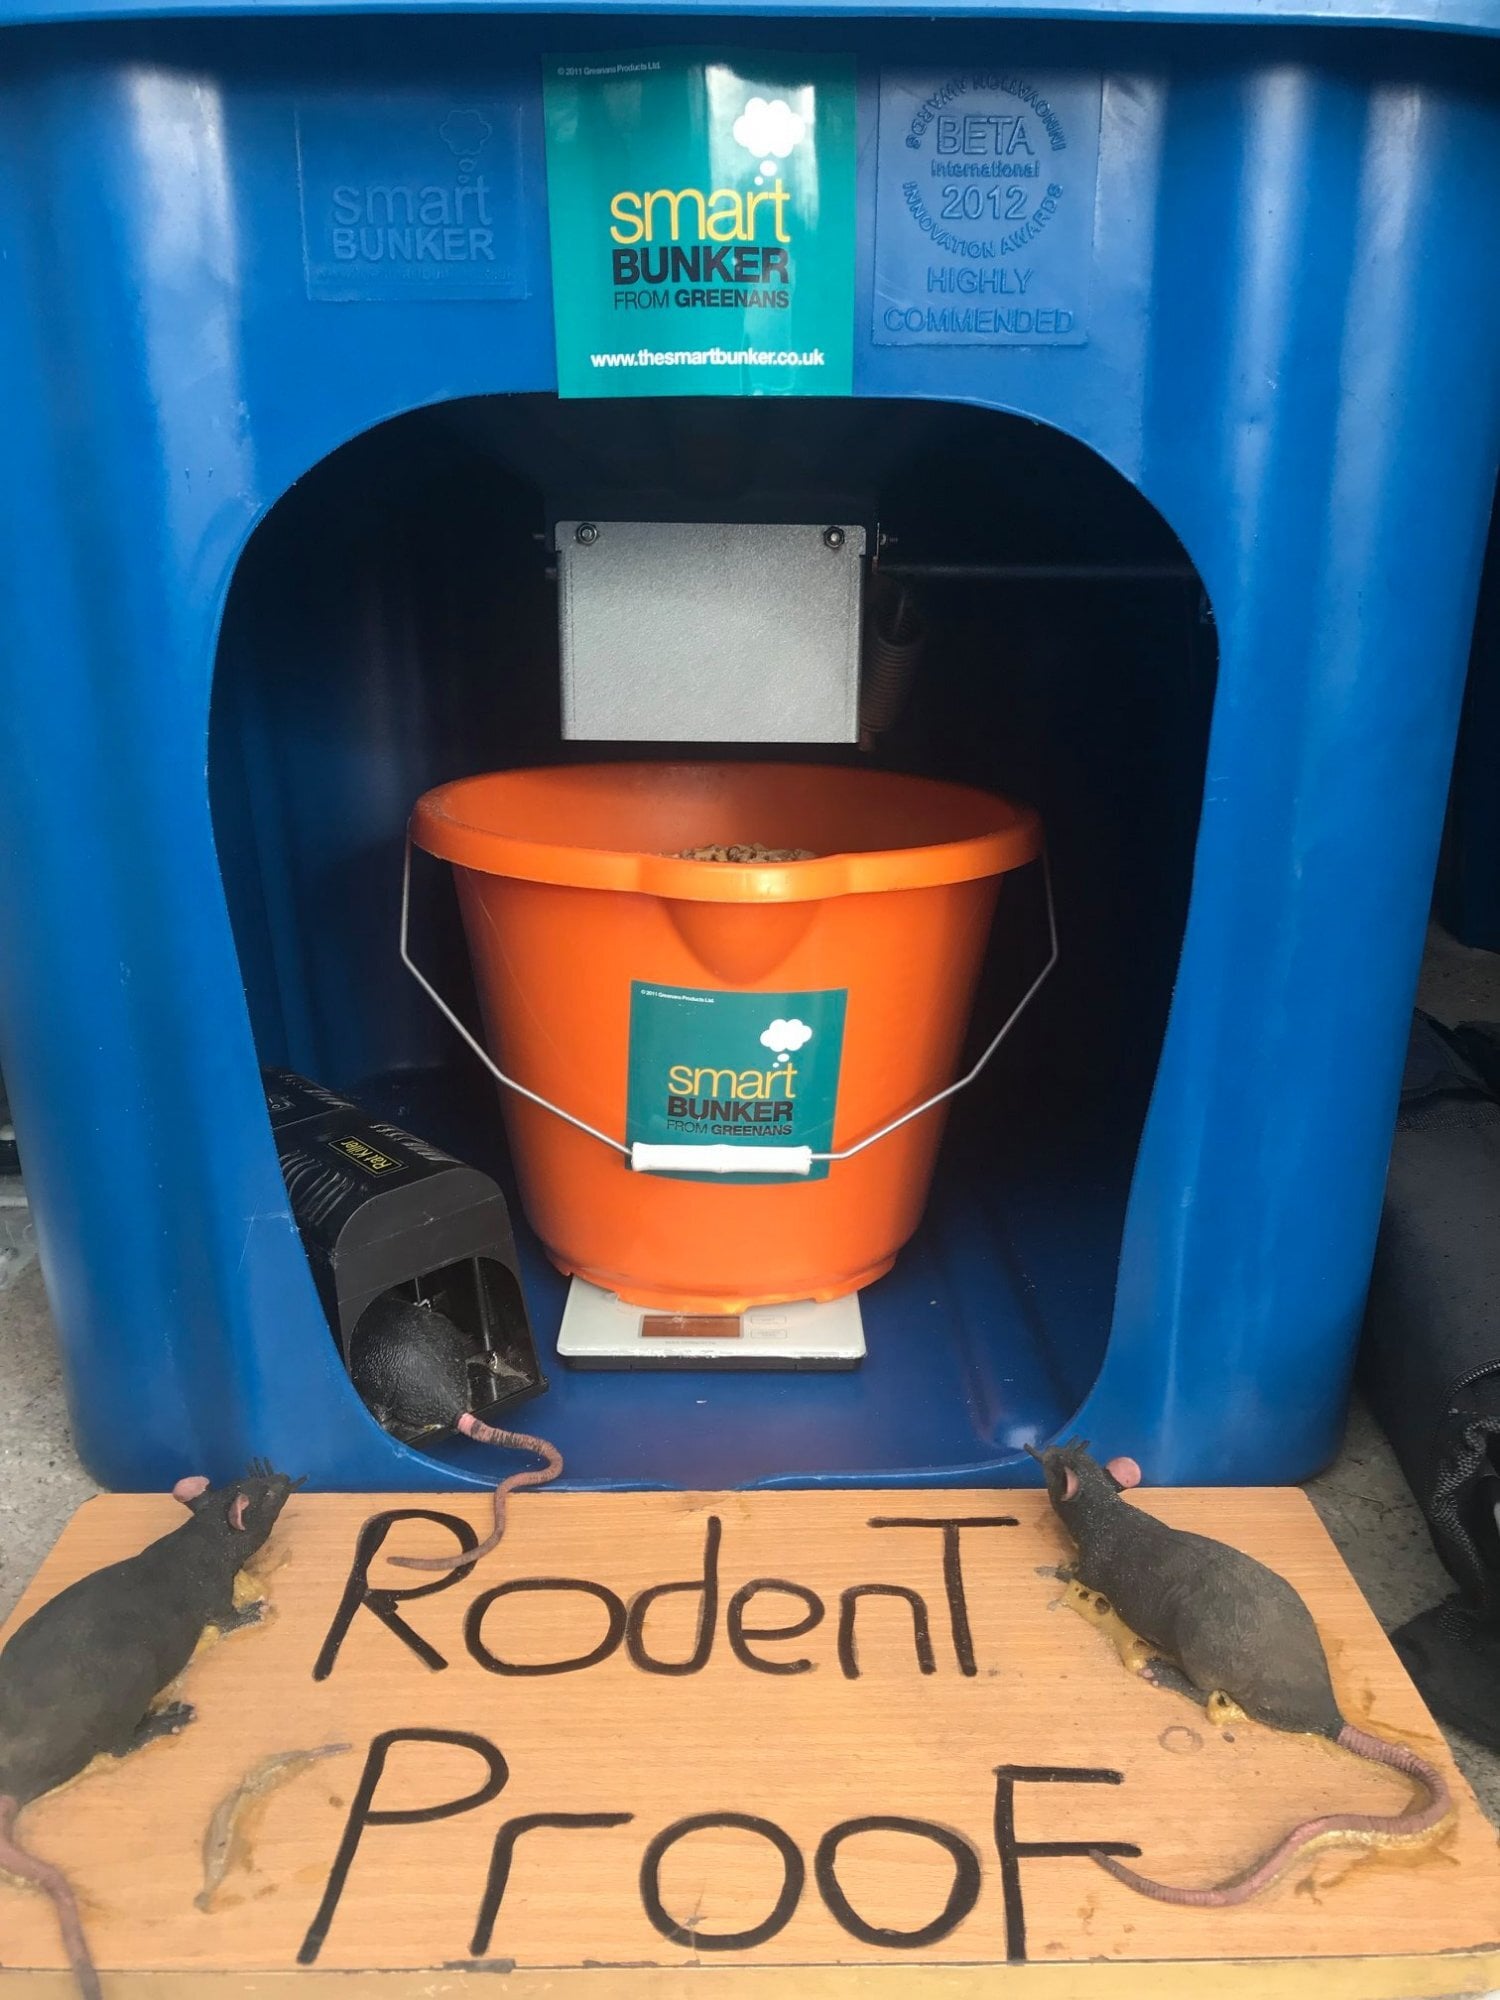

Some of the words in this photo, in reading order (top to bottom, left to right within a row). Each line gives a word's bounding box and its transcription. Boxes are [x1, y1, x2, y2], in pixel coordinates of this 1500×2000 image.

[617, 63, 647, 73] Products
[936, 115, 1036, 155] BETA
[931, 159, 1041, 178] International
[333, 175, 493, 226] smart
[610, 178, 791, 244] smart
[940, 184, 1028, 220] 2012
[903, 181, 996, 259] INNOVATION
[1000, 182, 1064, 256] AWARDS
[333, 228, 496, 261] BUNKER
[612, 245, 789, 285] BUNKER
[926, 266, 1034, 294] HIGHLY
[613, 290, 670, 310] FROM
[674, 289, 790, 309] GREENANS
[883, 306, 1074, 334] COMMENDED
[590, 347, 825, 368] www.thesmartbunker.co.uk
[668, 1062, 798, 1100] smart
[667, 1095, 793, 1123] BUNKER
[666, 1119, 708, 1134] FROM
[711, 1124, 792, 1136] GREENANS
[339, 1139, 374, 1159] Killer
[362, 1154, 393, 1171] Rat
